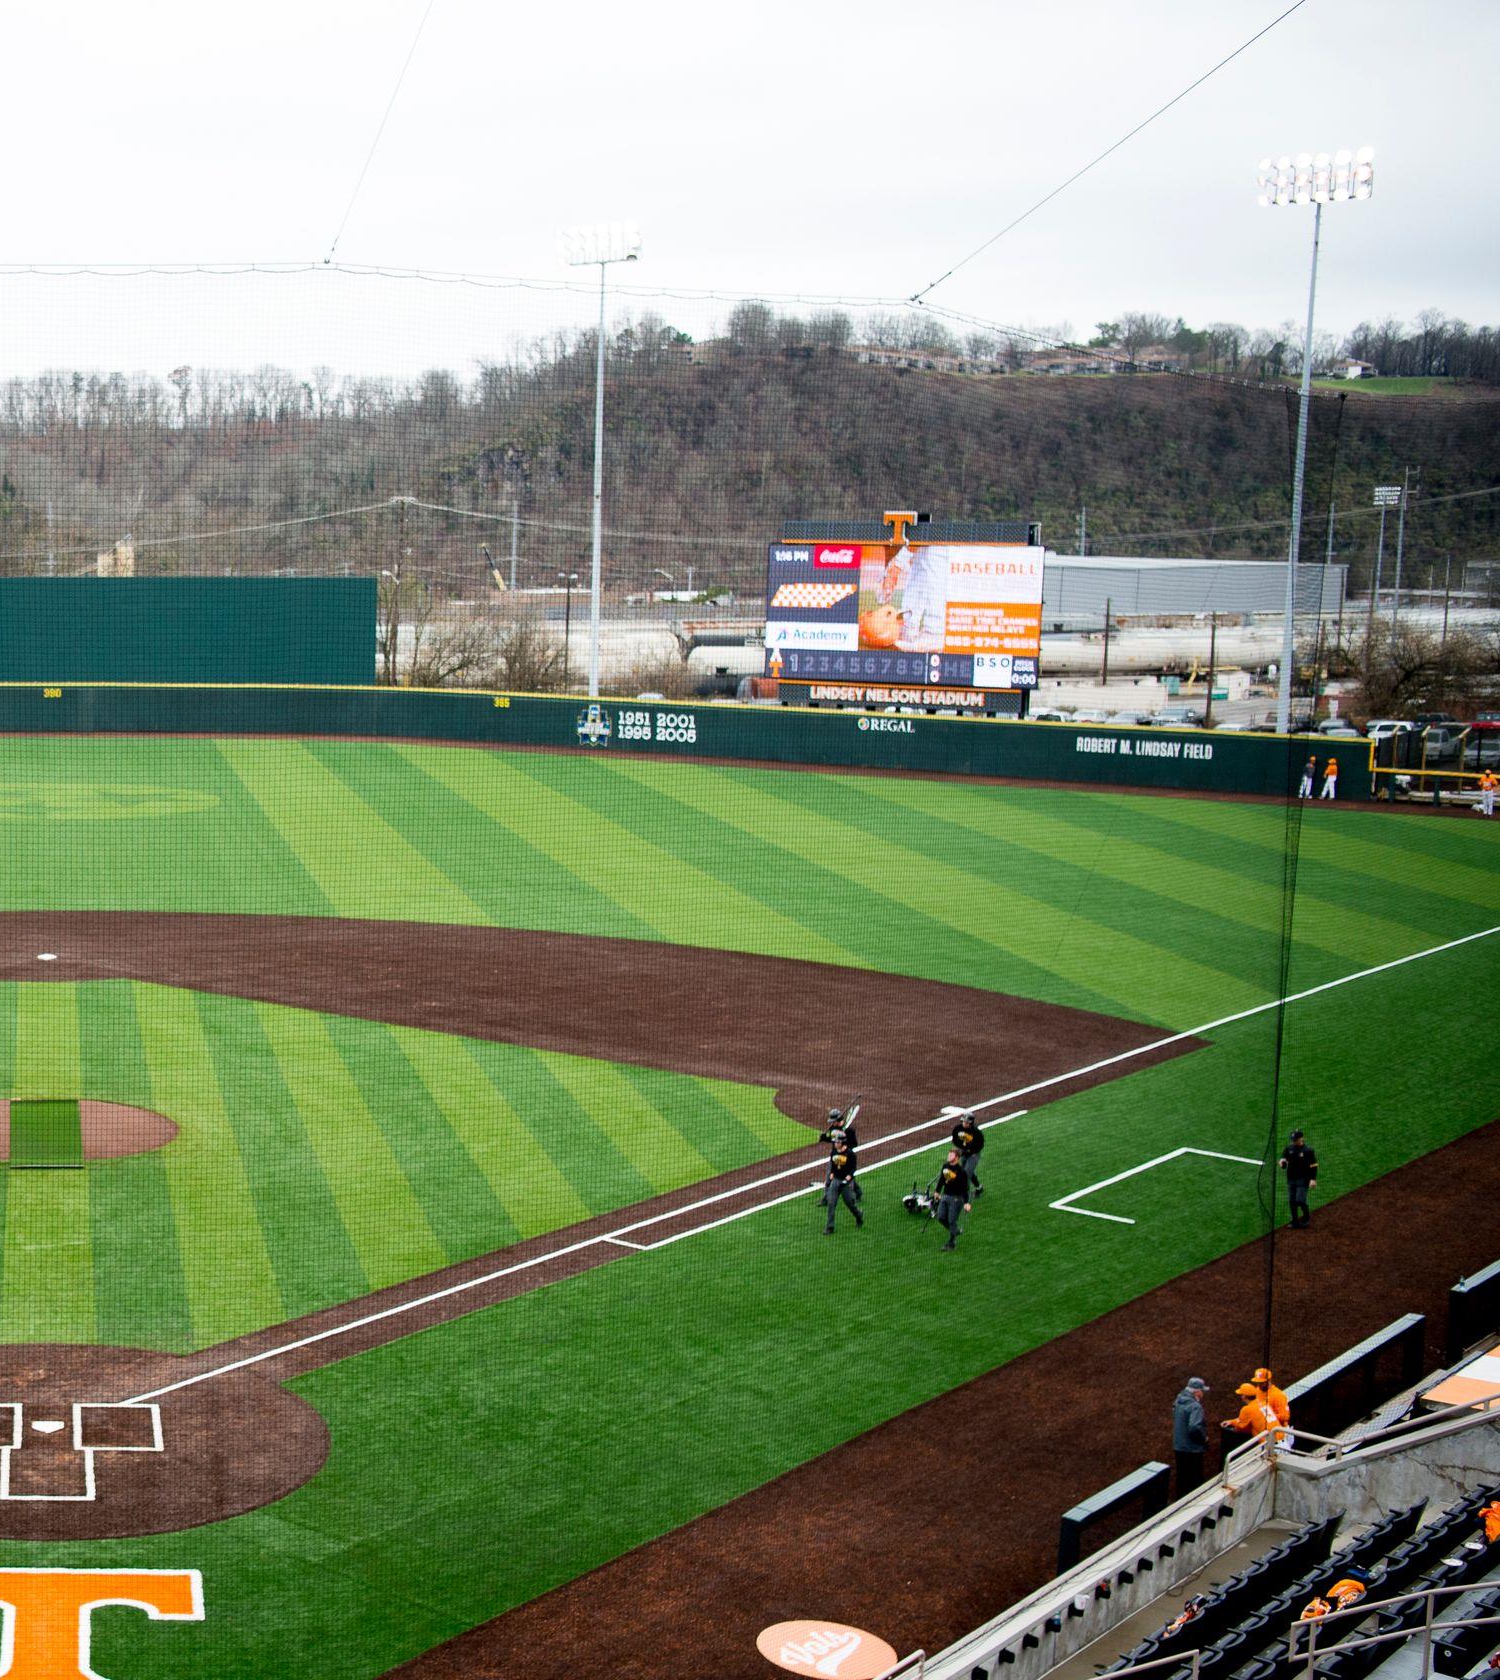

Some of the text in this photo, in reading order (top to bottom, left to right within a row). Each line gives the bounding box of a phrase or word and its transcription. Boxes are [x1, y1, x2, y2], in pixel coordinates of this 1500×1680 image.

[794, 551, 809, 562] PM
[950, 562, 1036, 575] BASEBALL
[794, 629, 849, 641] Academy
[790, 654, 798, 672] 1
[810, 686, 986, 706] LINDSEY NELSON STADIUM
[618, 711, 695, 727] 1951 2001
[871, 718, 916, 733] REGAL
[618, 725, 651, 740] 1995
[656, 727, 697, 742] 2005
[1076, 737, 1213, 760] ROBERT M. LINDSAY FIELD
